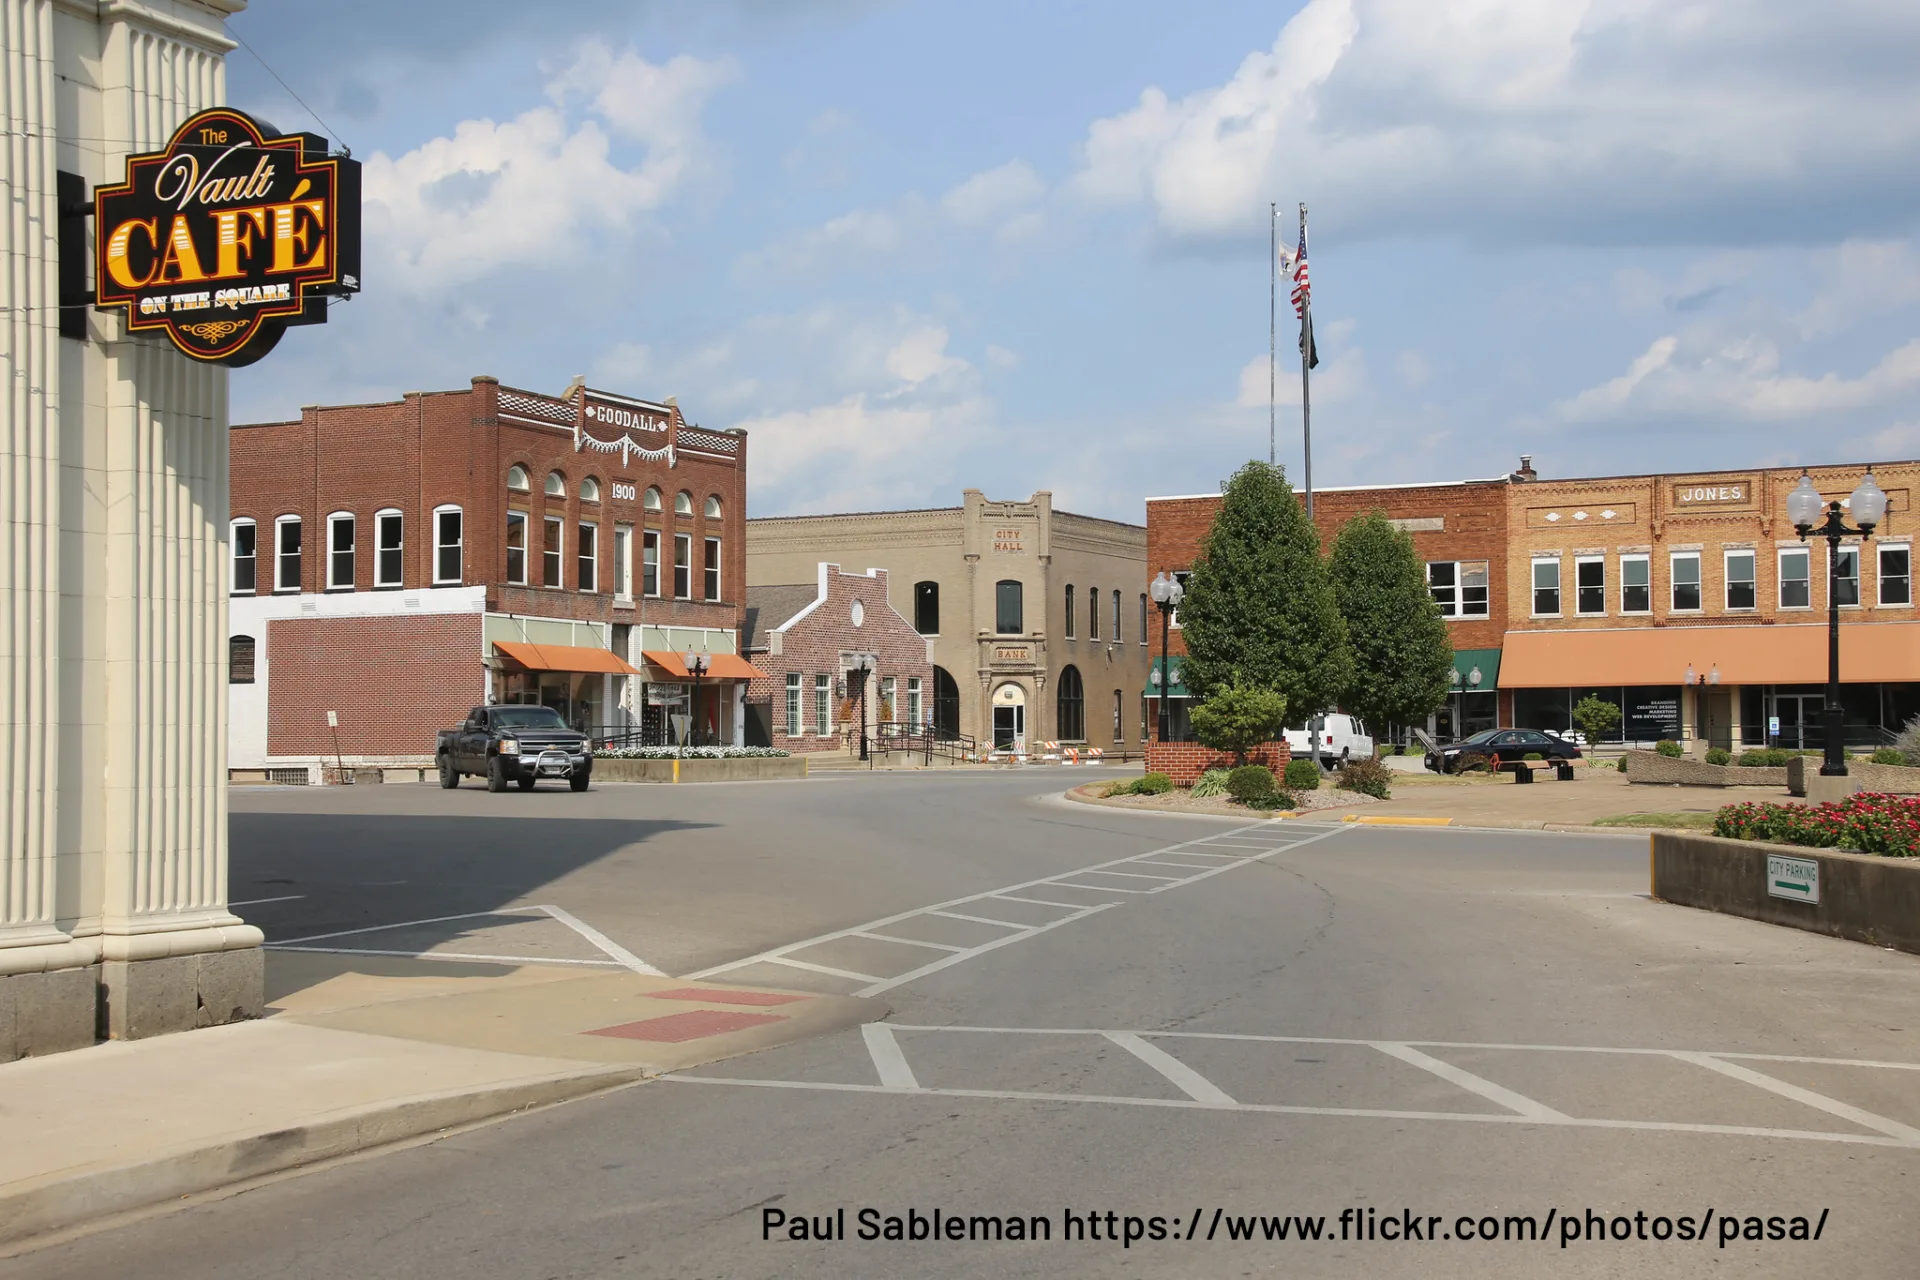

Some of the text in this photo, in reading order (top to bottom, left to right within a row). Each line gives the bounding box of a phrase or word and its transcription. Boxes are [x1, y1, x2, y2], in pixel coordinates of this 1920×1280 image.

[200, 128, 228, 145] The
[155, 141, 275, 211] Vault
[107, 178, 326, 289] CAFÉ
[140, 283, 290, 314] ON THE SQUARE
[611, 482, 635, 501] 1900
[996, 531, 1020, 539] CITY
[994, 542, 1023, 551] HALL
[997, 650, 1026, 658] BANK
[1769, 860, 1816, 882] CITY PARKING
